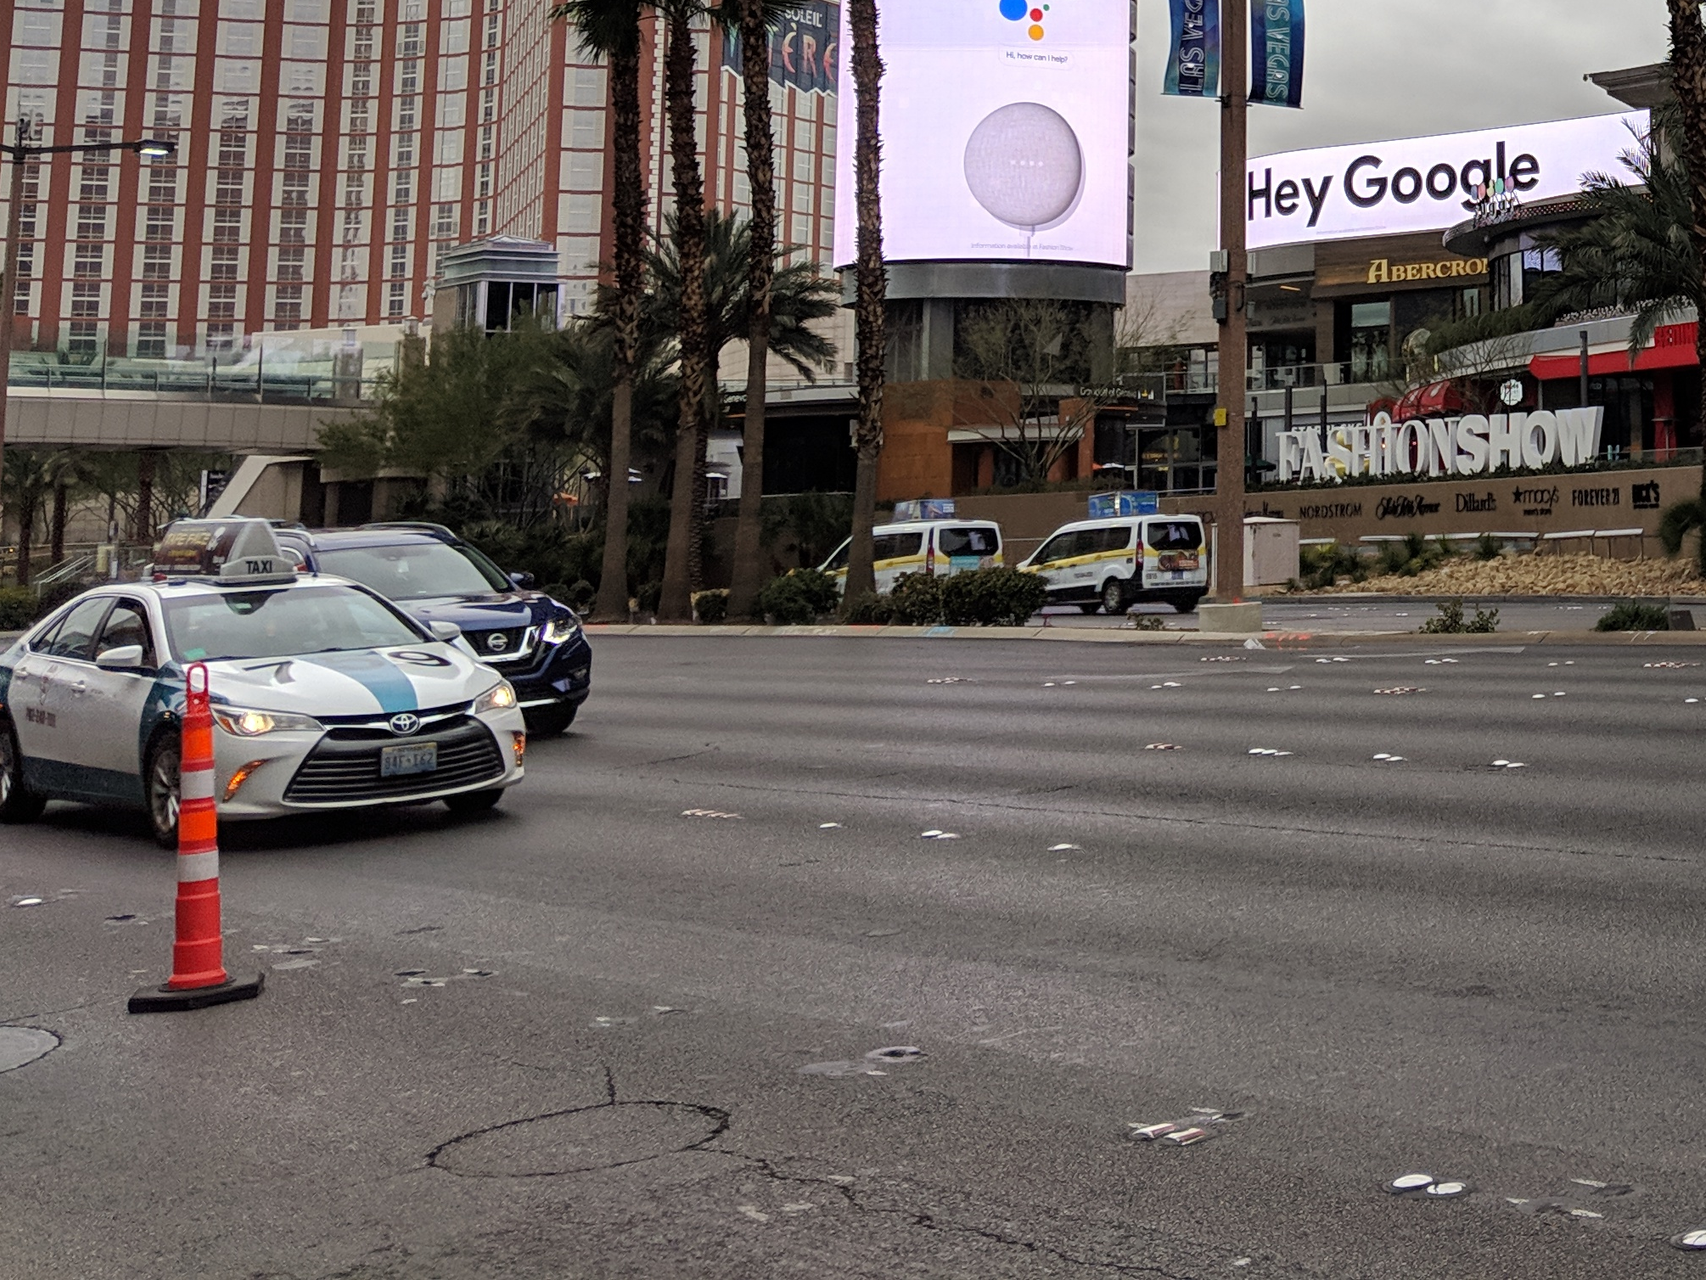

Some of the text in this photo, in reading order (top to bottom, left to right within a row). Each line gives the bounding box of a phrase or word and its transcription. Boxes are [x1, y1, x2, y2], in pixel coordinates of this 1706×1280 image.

[1005, 51, 1015, 60] Hi,
[1017, 52, 1033, 61] how
[1051, 55, 1069, 64] help?
[1266, 26, 1291, 99] VEGAS
[1179, 46, 1205, 93] LAS
[1248, 141, 1540, 228] Hey Google
[1455, 492, 1497, 513] Dillard's
[1572, 489, 1609, 507] FOREVER
[1299, 502, 1363, 519] NORDSTROM
[246, 560, 273, 574] TAXI
